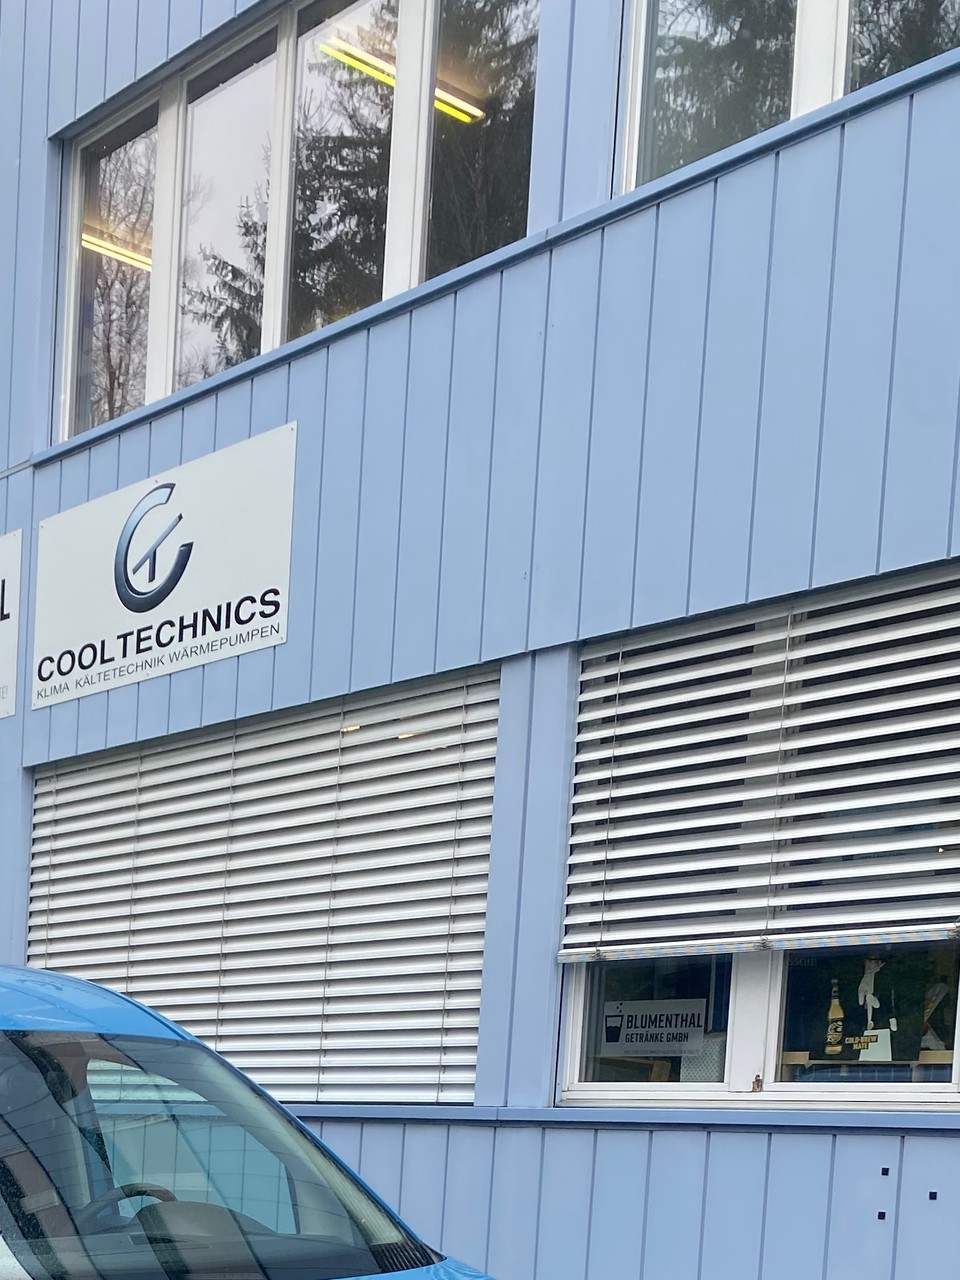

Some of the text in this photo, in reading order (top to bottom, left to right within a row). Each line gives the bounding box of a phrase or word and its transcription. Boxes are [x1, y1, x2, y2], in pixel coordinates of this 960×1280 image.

[37, 588, 281, 682] COOLTECHNICS
[36, 623, 281, 700] KLIMA KÄLTETECHNIK WÄRMEPUMPEN
[625, 1031, 689, 1043] GETRÄNKE GMBH
[626, 1013, 703, 1029] BLUMENTHAL
